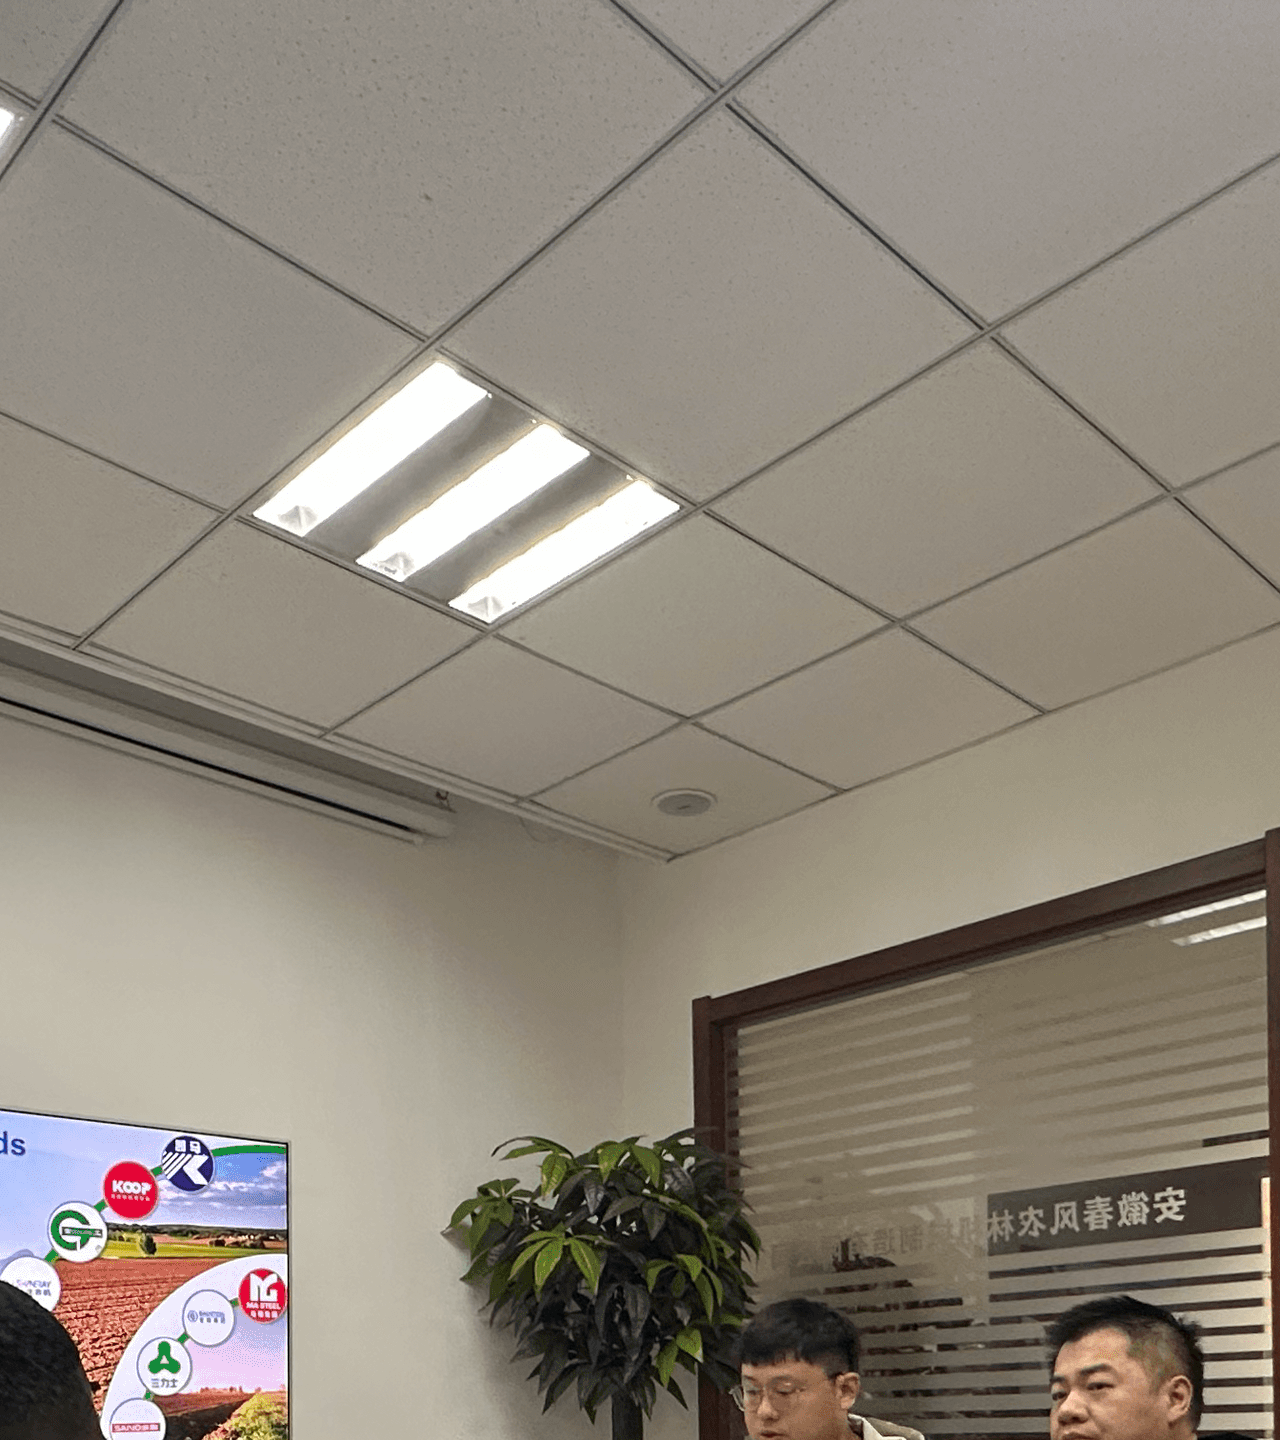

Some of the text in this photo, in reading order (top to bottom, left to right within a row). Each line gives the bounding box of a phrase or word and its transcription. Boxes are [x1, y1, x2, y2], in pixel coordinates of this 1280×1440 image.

[112, 1180, 152, 1195] KOOP
[150, 1378, 179, 1389] 三力士
